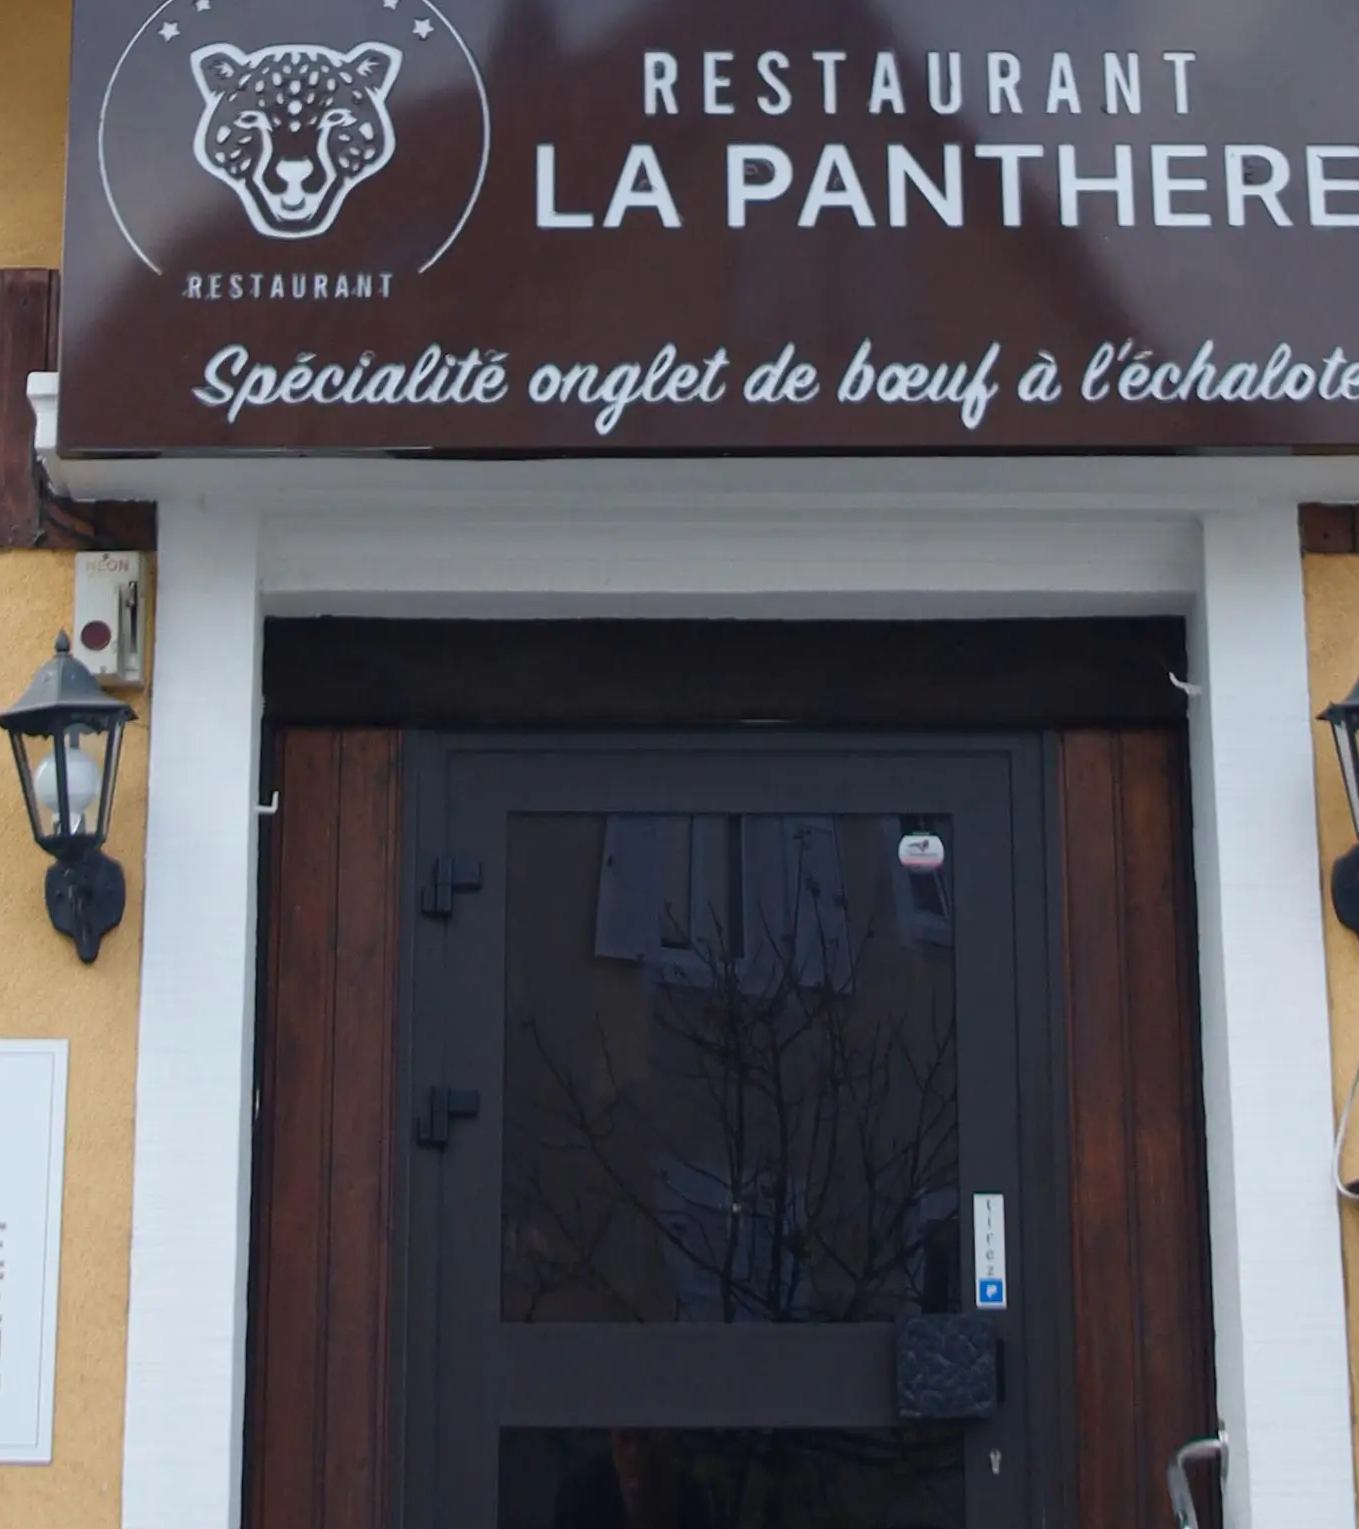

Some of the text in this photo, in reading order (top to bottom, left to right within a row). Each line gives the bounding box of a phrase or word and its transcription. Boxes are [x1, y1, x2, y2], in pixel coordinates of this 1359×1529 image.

[642, 50, 1198, 116] RESTAURANT
[535, 143, 684, 228] LA
[185, 272, 394, 301] RESTAURANT
[192, 343, 510, 423] Spécialité
[527, 343, 732, 435] onglet
[743, 342, 821, 403] de
[1017, 350, 1063, 403] à
